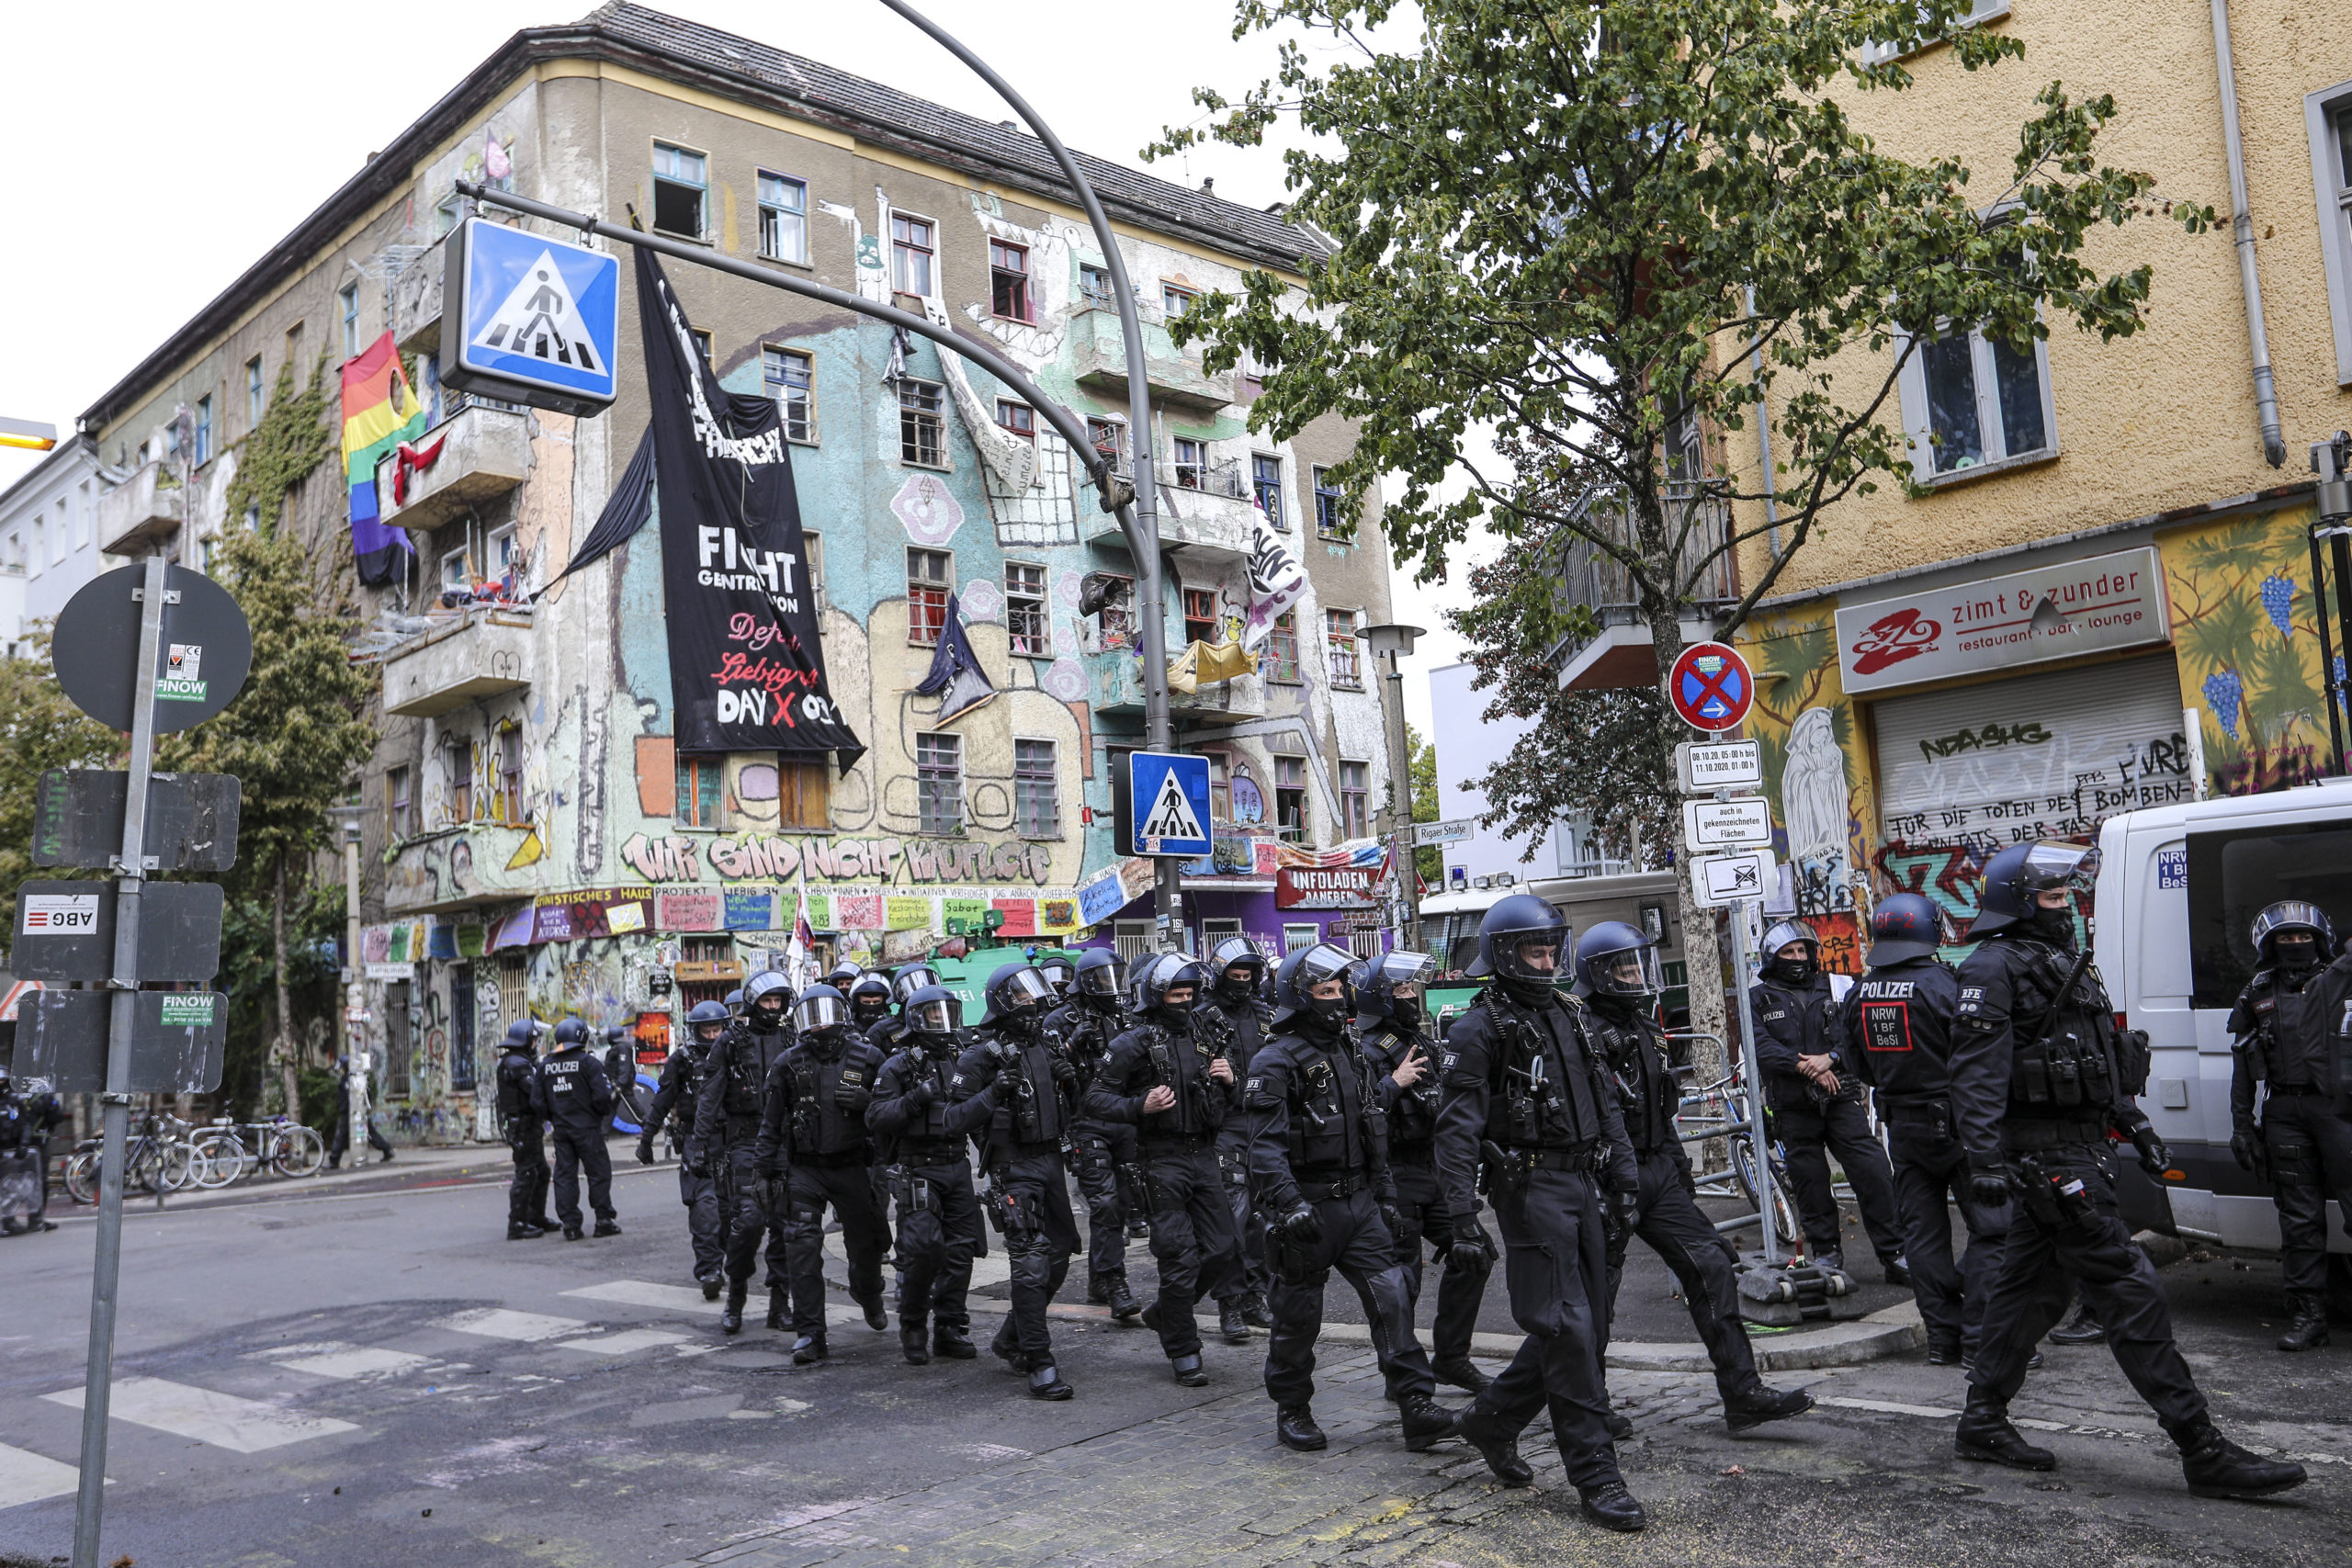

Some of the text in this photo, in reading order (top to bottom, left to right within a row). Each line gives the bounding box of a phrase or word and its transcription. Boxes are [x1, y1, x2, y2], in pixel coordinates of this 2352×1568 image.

[1952, 571, 2139, 624] zimt & zunder
[1959, 628, 2032, 651] restaurant
[2087, 610, 2143, 628] lounge
[157, 680, 206, 694] FINOW
[717, 687, 767, 727] DAY
[771, 691, 796, 728] X
[1721, 750, 1738, 759] 05:00
[1739, 750, 1744, 758] h
[1745, 749, 1755, 758] bis
[1731, 761, 1749, 770] 01:00
[1749, 761, 1755, 769] h
[1719, 806, 1743, 816] auch in
[1888, 814, 1930, 838] FÜR
[1983, 801, 2035, 818] TOTEN
[2095, 781, 2190, 811] BOMBEN-
[1703, 818, 1760, 829] gekennzeichneten
[1421, 823, 1466, 840] Rigaer Straße
[1720, 829, 1746, 838] Flächen
[2012, 822, 2047, 842] DER
[2162, 863, 2187, 875] 1 B
[1292, 871, 1369, 892] INFOLADEN
[620, 887, 652, 899] HAUS
[655, 886, 707, 897] PROJEKT
[723, 886, 757, 896] LIEBIG
[763, 886, 779, 896] 34
[993, 888, 1006, 898] DAS
[1084, 884, 1115, 904] Akelius
[1306, 890, 1353, 905] DANEBEN
[726, 896, 748, 904] WBA
[945, 902, 978, 912] Sabot
[52, 912, 93, 926] ABG
[1860, 981, 1916, 998] POLIZEI
[1961, 988, 1982, 999] BFE
[164, 996, 214, 1008] FINOW
[1763, 1010, 1785, 1022] POLIZEI
[1871, 1008, 1896, 1021] NRW
[1873, 1022, 1895, 1032] 1 BF
[1876, 1034, 1899, 1046] BeSi
[545, 1060, 579, 1075] POLIZEI
